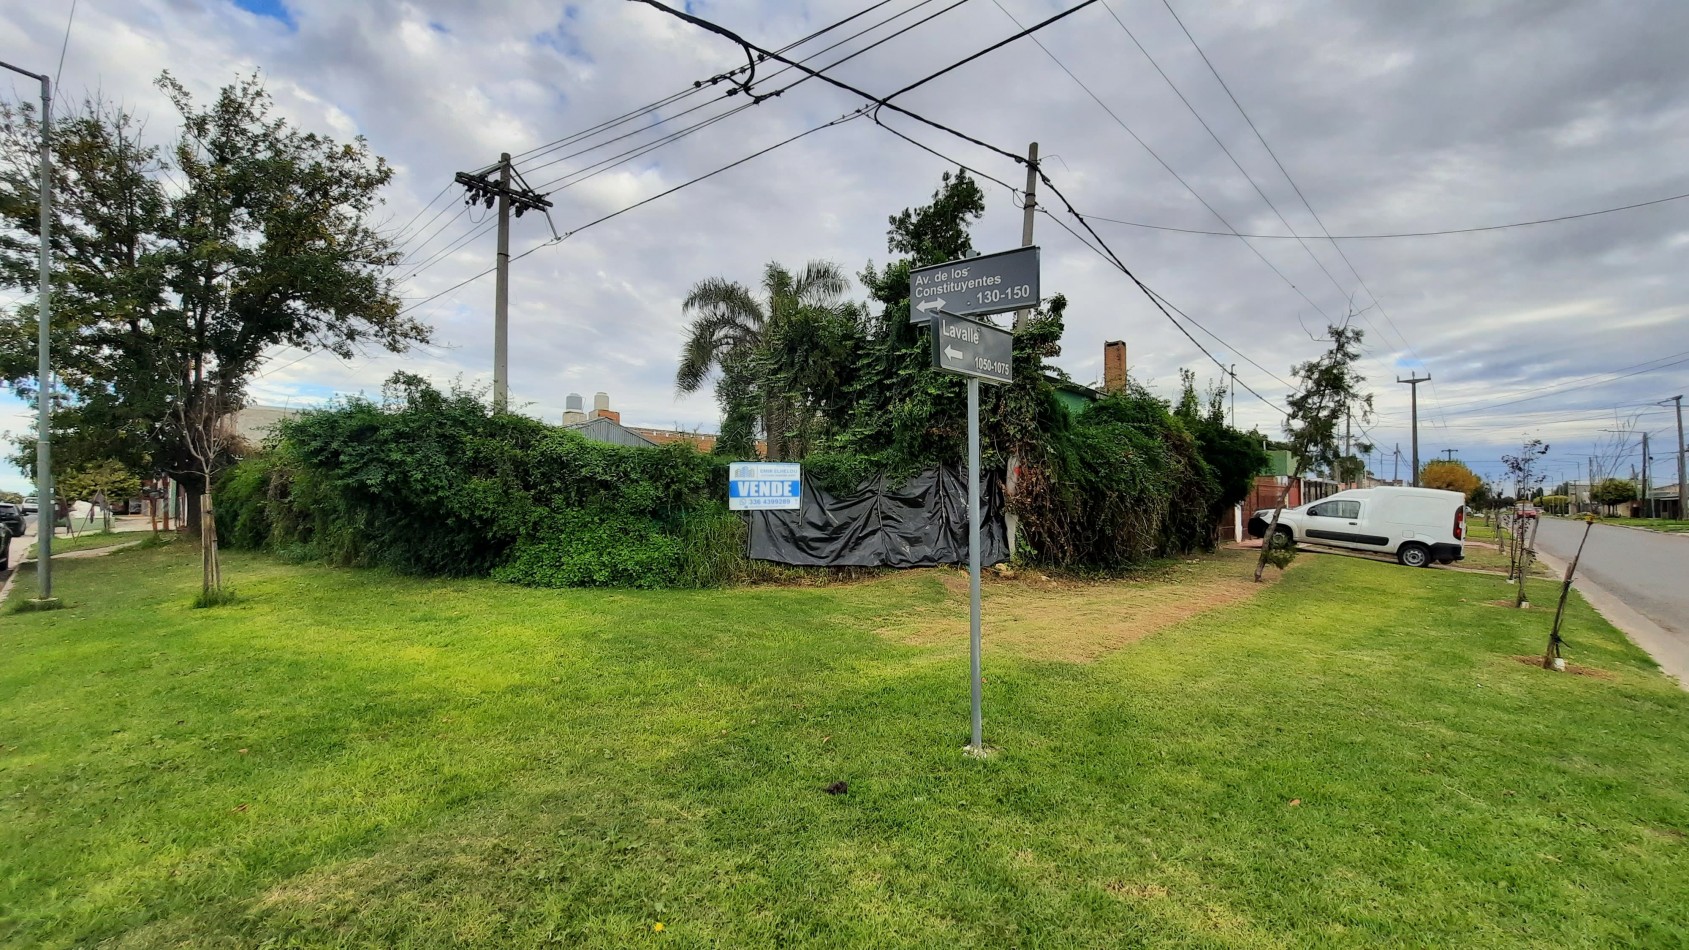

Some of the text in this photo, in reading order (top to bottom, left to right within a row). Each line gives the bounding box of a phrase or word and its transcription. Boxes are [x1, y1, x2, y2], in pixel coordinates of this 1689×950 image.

[915, 269, 969, 286] Av. de los
[915, 275, 1002, 298] Constituyentes
[976, 285, 1030, 304] 130-150
[942, 320, 979, 344] Lavalle
[974, 356, 1010, 375] 1050-1075
[737, 481, 793, 497] VENDE
